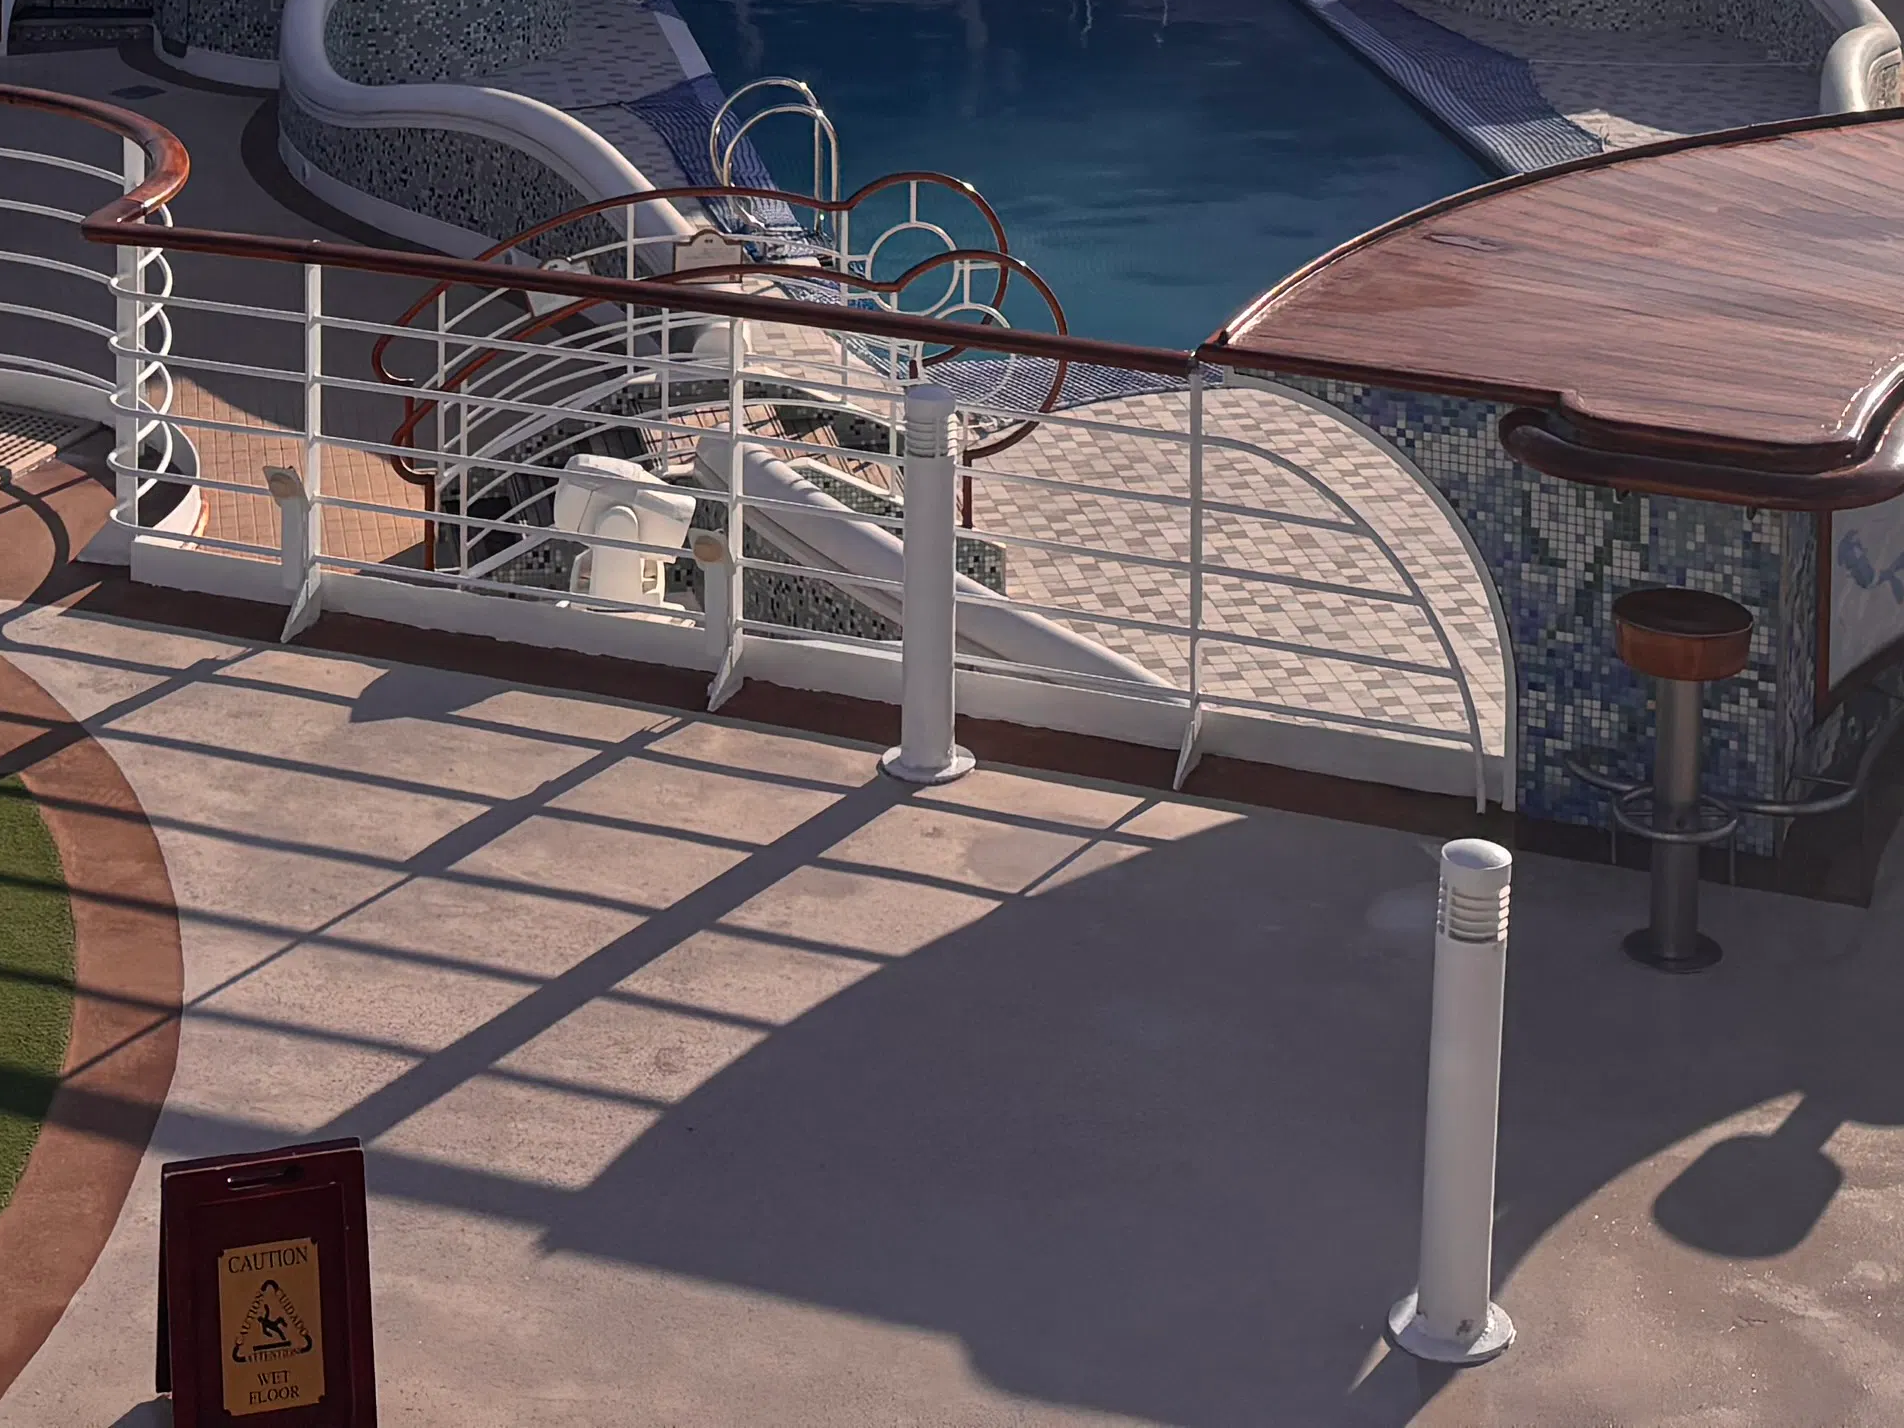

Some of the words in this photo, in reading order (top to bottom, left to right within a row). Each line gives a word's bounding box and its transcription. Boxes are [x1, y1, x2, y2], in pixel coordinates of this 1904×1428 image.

[228, 1245, 308, 1274] CAUTION
[274, 1287, 309, 1337] CUIDADO
[257, 1369, 291, 1386] WET
[249, 1385, 300, 1405] FLOOR
